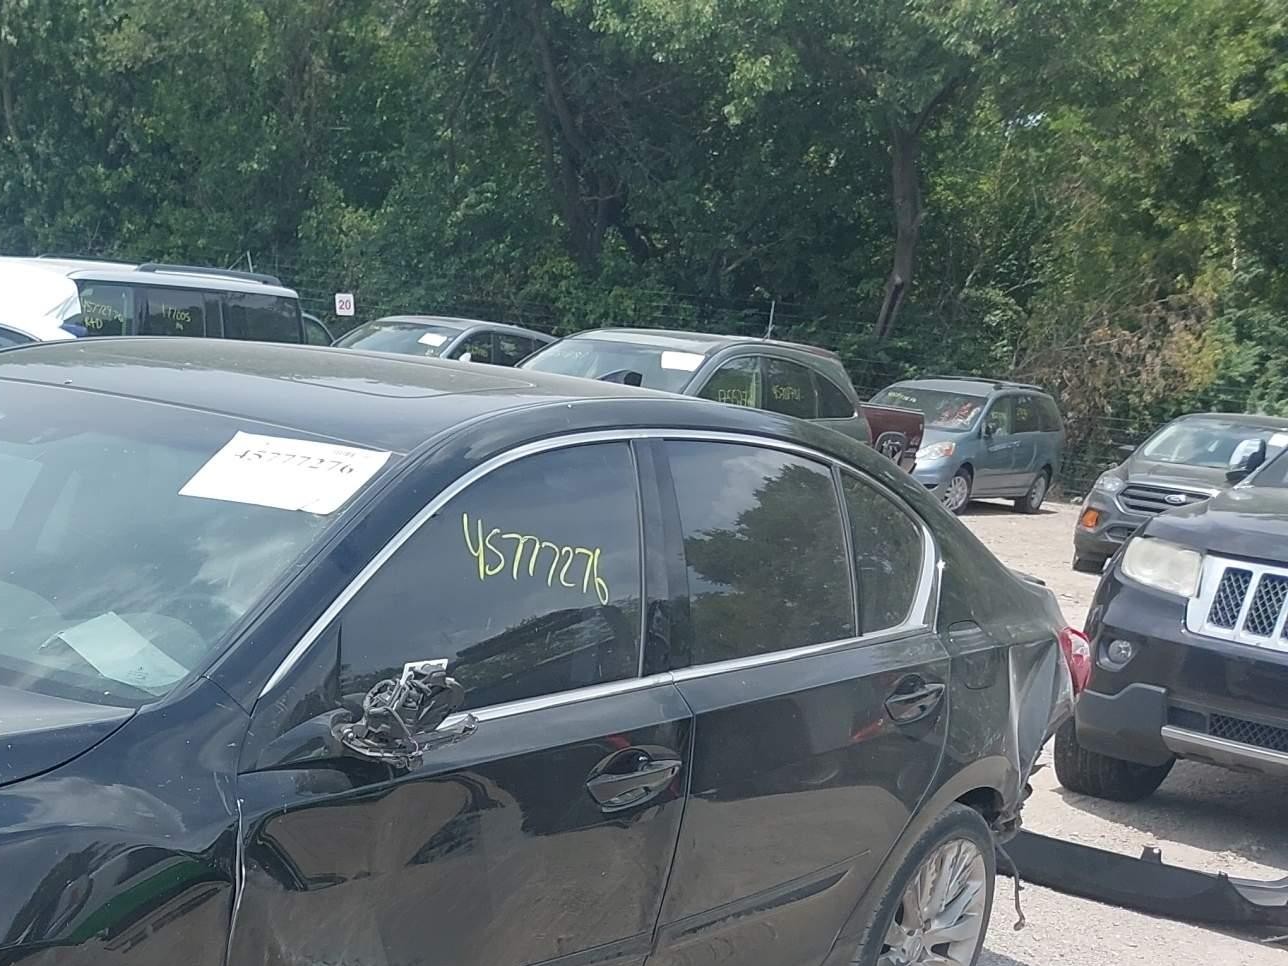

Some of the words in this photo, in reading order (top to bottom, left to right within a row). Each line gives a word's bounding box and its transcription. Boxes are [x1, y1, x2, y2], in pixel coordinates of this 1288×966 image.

[338, 299, 351, 310] 20
[234, 449, 355, 474] 45777276
[463, 513, 609, 605] 45777276
